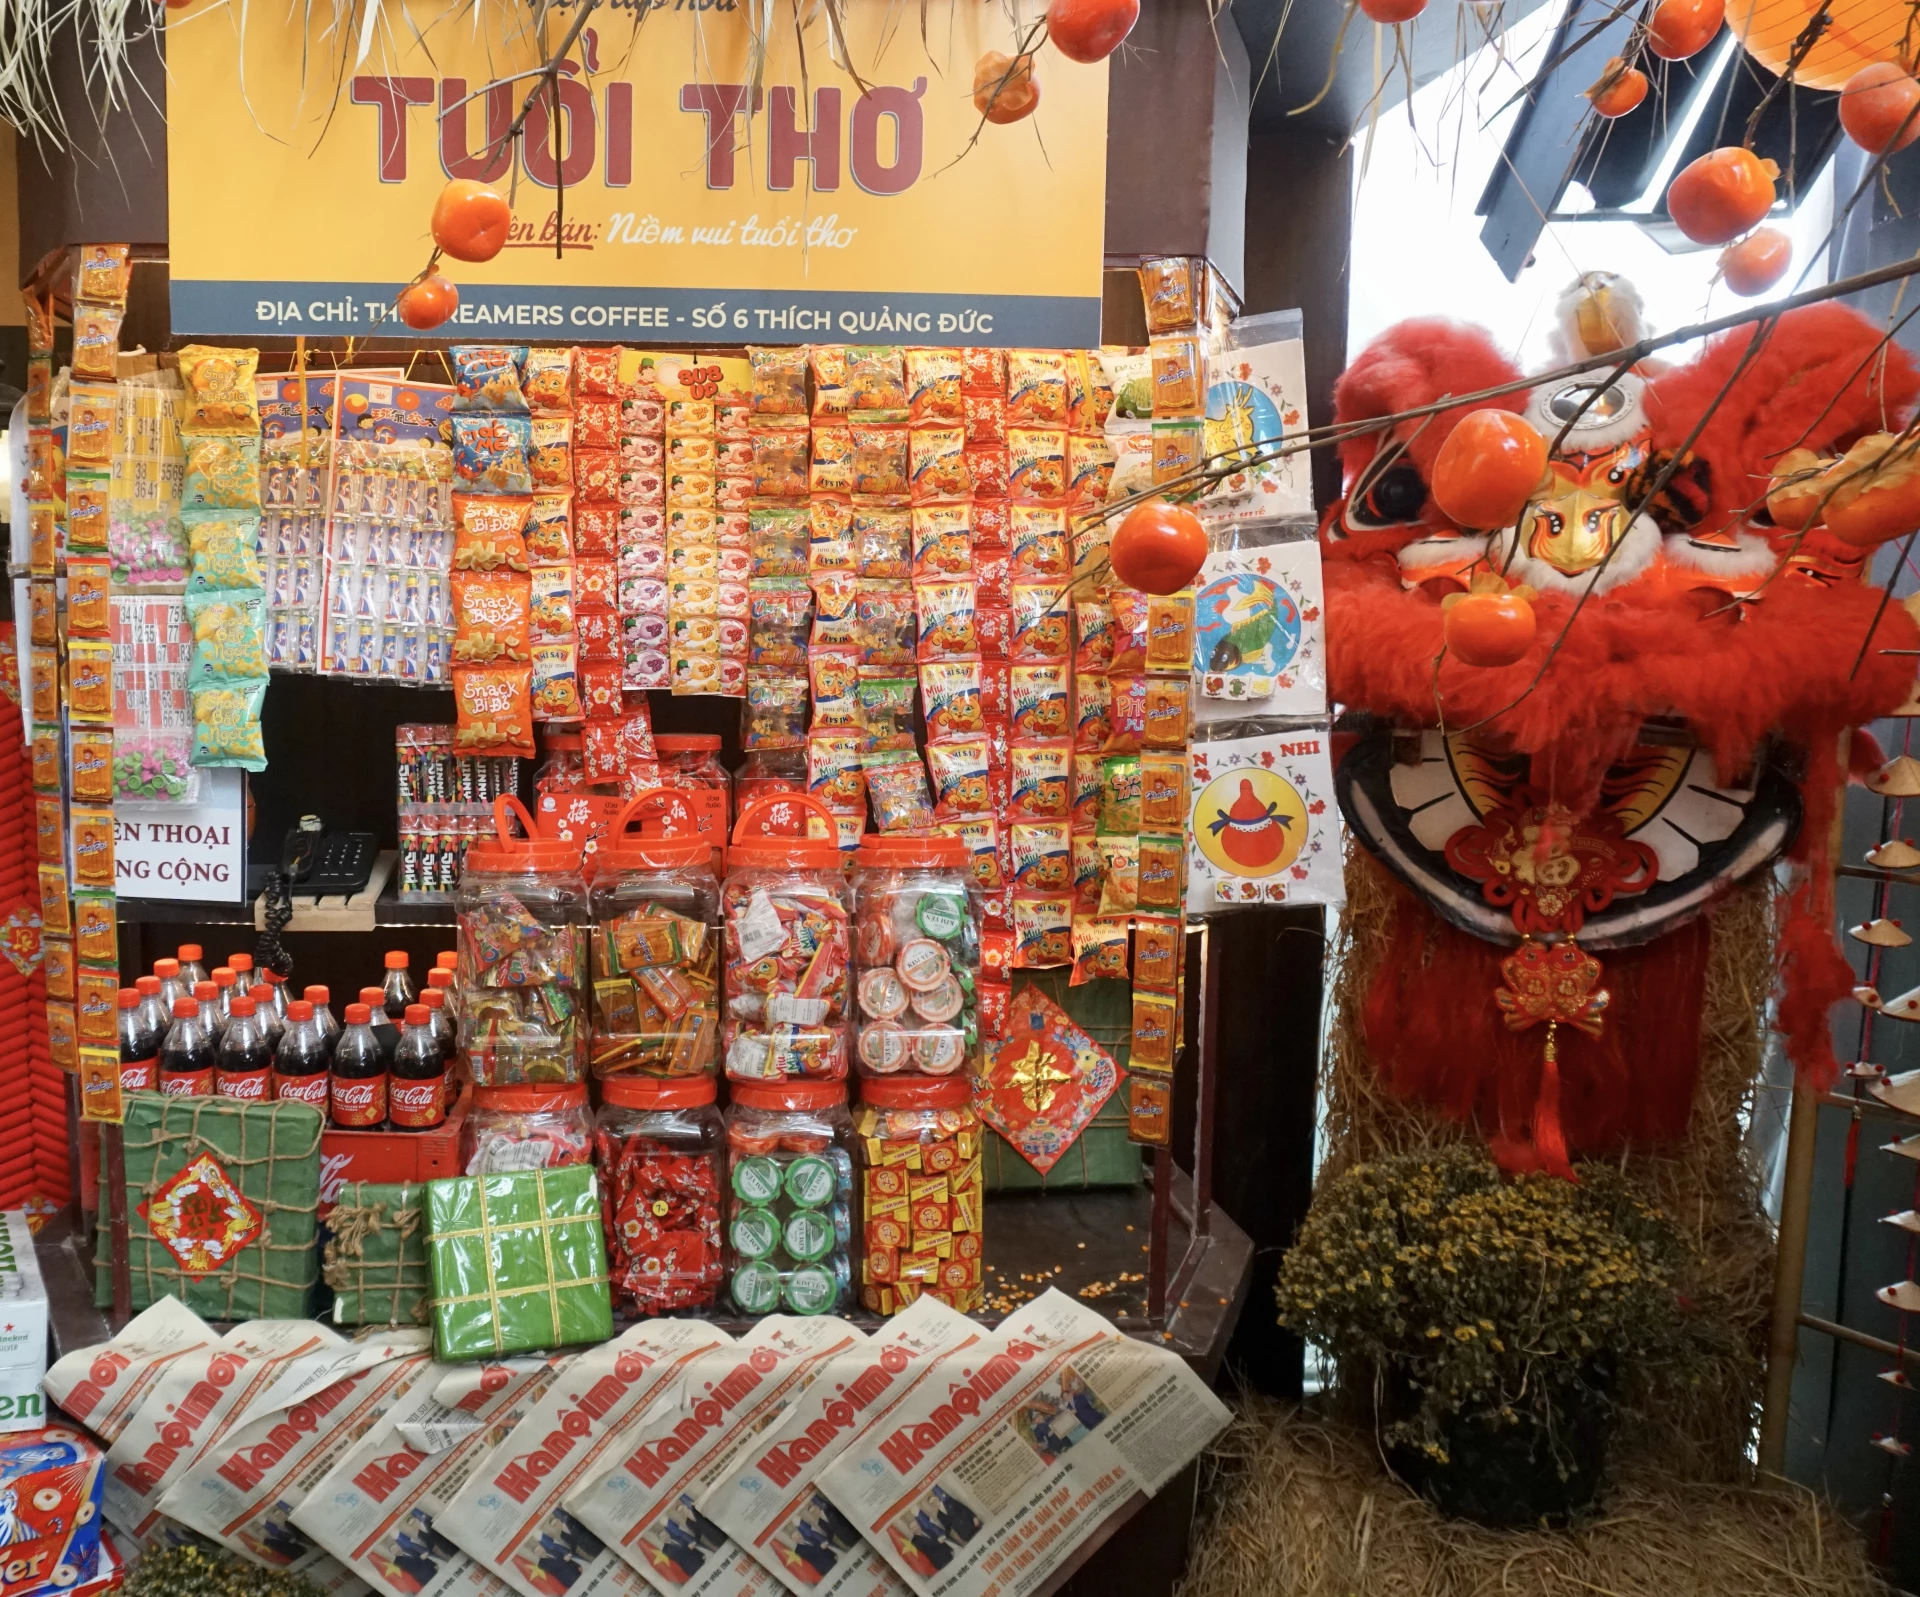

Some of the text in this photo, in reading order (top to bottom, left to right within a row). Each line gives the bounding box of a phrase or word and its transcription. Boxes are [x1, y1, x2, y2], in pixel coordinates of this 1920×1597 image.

[350, 26, 928, 196] TUỔI THƠ
[539, 210, 602, 243] bán:
[607, 212, 686, 245] Niềm
[691, 219, 737, 245] vui
[740, 214, 801, 248] tuổi
[803, 213, 859, 249] thơ
[256, 301, 301, 326] ĐỊA
[308, 296, 359, 322] CHỈ:
[365, 302, 402, 324] TH
[450, 303, 564, 325] REAMERS
[569, 306, 669, 328] COFFEE
[692, 302, 727, 329] SỐ
[733, 309, 749, 329] 6
[754, 305, 831, 331] THÍCH
[838, 305, 931, 335] QUẢNG
[937, 308, 994, 334] ĐỨC
[678, 365, 723, 386] BUB
[690, 382, 718, 400] UP
[463, 594, 518, 610] Snack
[463, 681, 519, 698] Snack
[472, 698, 488, 714] Bí
[1280, 740, 1321, 757] NHI
[114, 817, 230, 850] ỆN THOẠI
[114, 857, 230, 886] NG CỘNG
[279, 1077, 328, 1100] Coca-Cola
